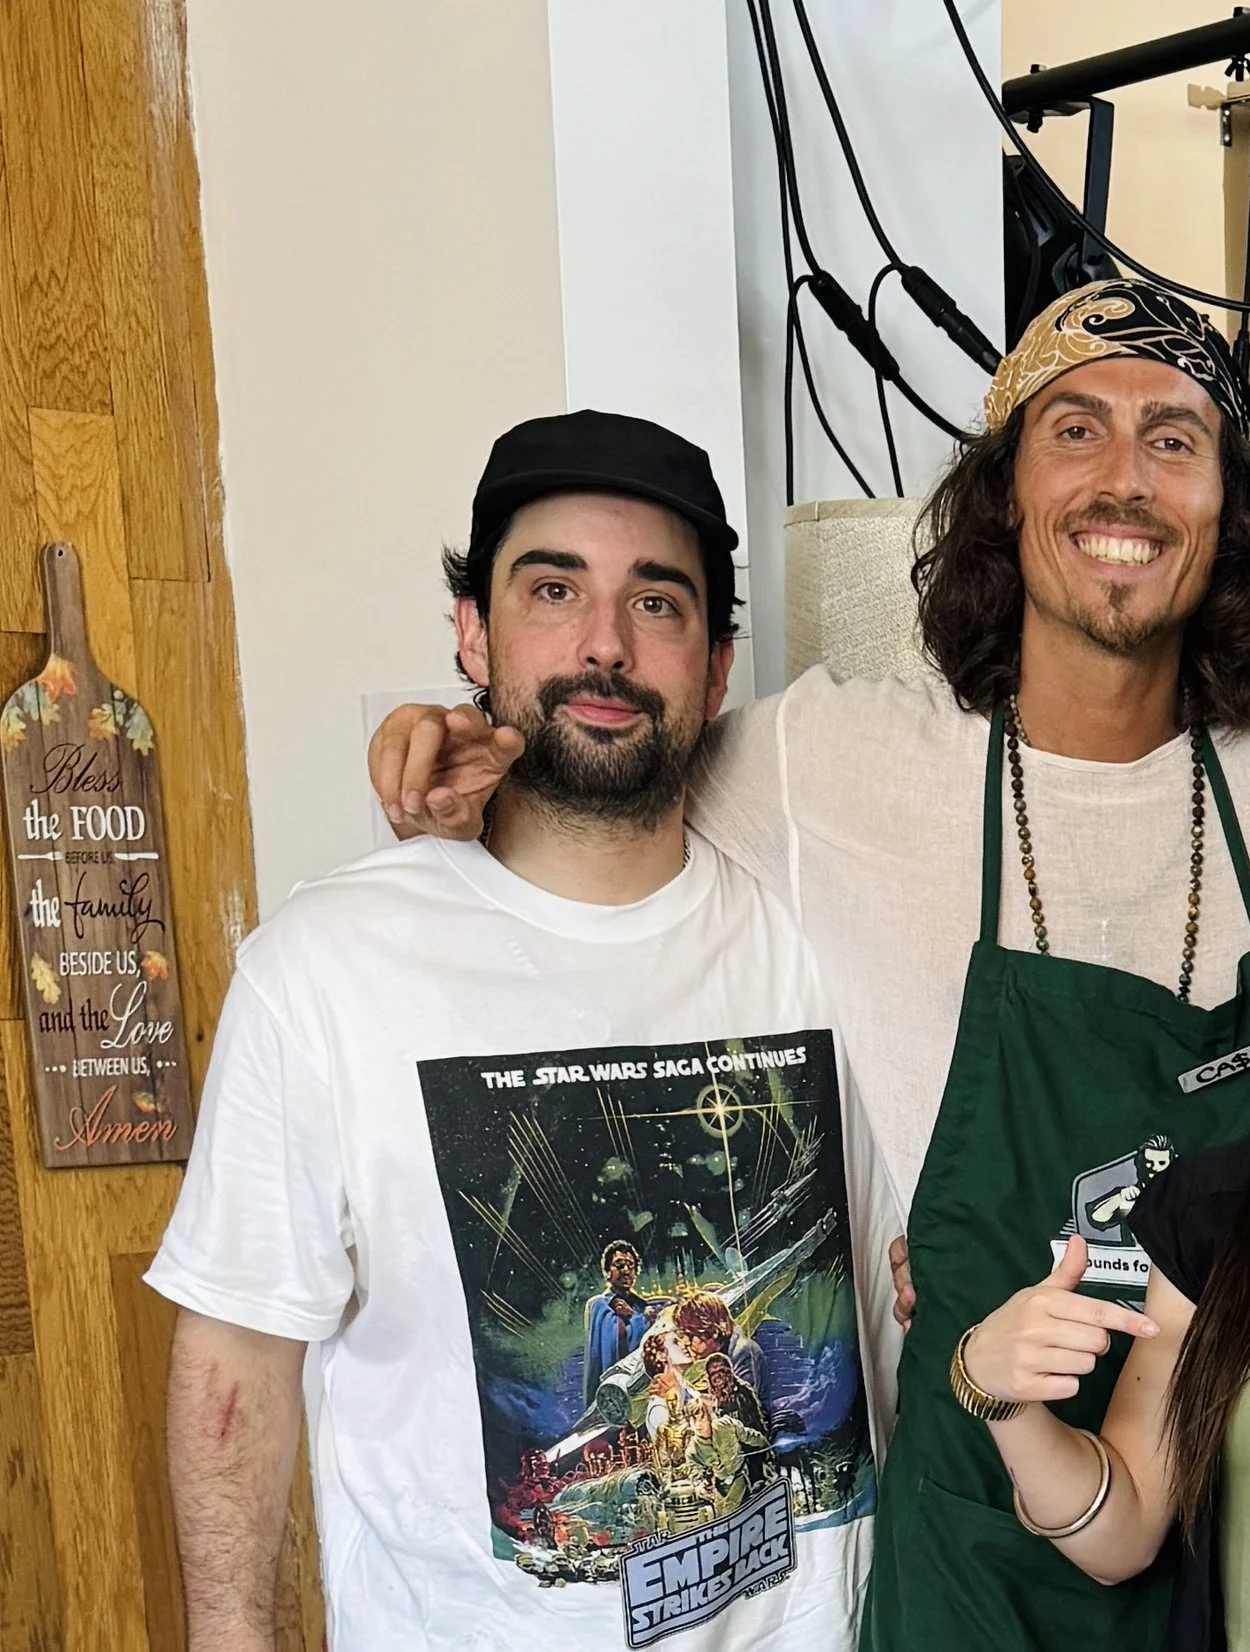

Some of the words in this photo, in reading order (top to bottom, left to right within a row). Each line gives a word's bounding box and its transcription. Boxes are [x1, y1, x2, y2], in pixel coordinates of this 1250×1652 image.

[30, 743, 121, 794] Bless
[23, 799, 63, 840] the
[70, 805, 146, 841] FOOD
[65, 850, 100, 865] BEFORE
[30, 878, 61, 928] the
[64, 871, 166, 944] family
[59, 951, 112, 976] BESIDE
[116, 950, 141, 978] US,
[39, 1000, 75, 1033] and
[79, 999, 110, 1031] the
[100, 980, 174, 1049] Love
[72, 1058, 129, 1077] BETWEEN
[131, 1056, 151, 1077] US,
[481, 1070, 526, 1089] THE
[532, 1065, 590, 1086] STAR
[590, 1061, 648, 1082] WARS
[653, 1057, 705, 1078] SAGA
[706, 1046, 807, 1074] CONTINUES
[54, 1085, 177, 1151] Amen
[1087, 1258, 1130, 1271] ounds
[1133, 1260, 1149, 1272] fo
[626, 1497, 788, 1607] EMPIRE
[632, 1530, 671, 1552] STAR
[631, 1568, 733, 1632] STRIKES
[734, 1534, 789, 1583] BACK
